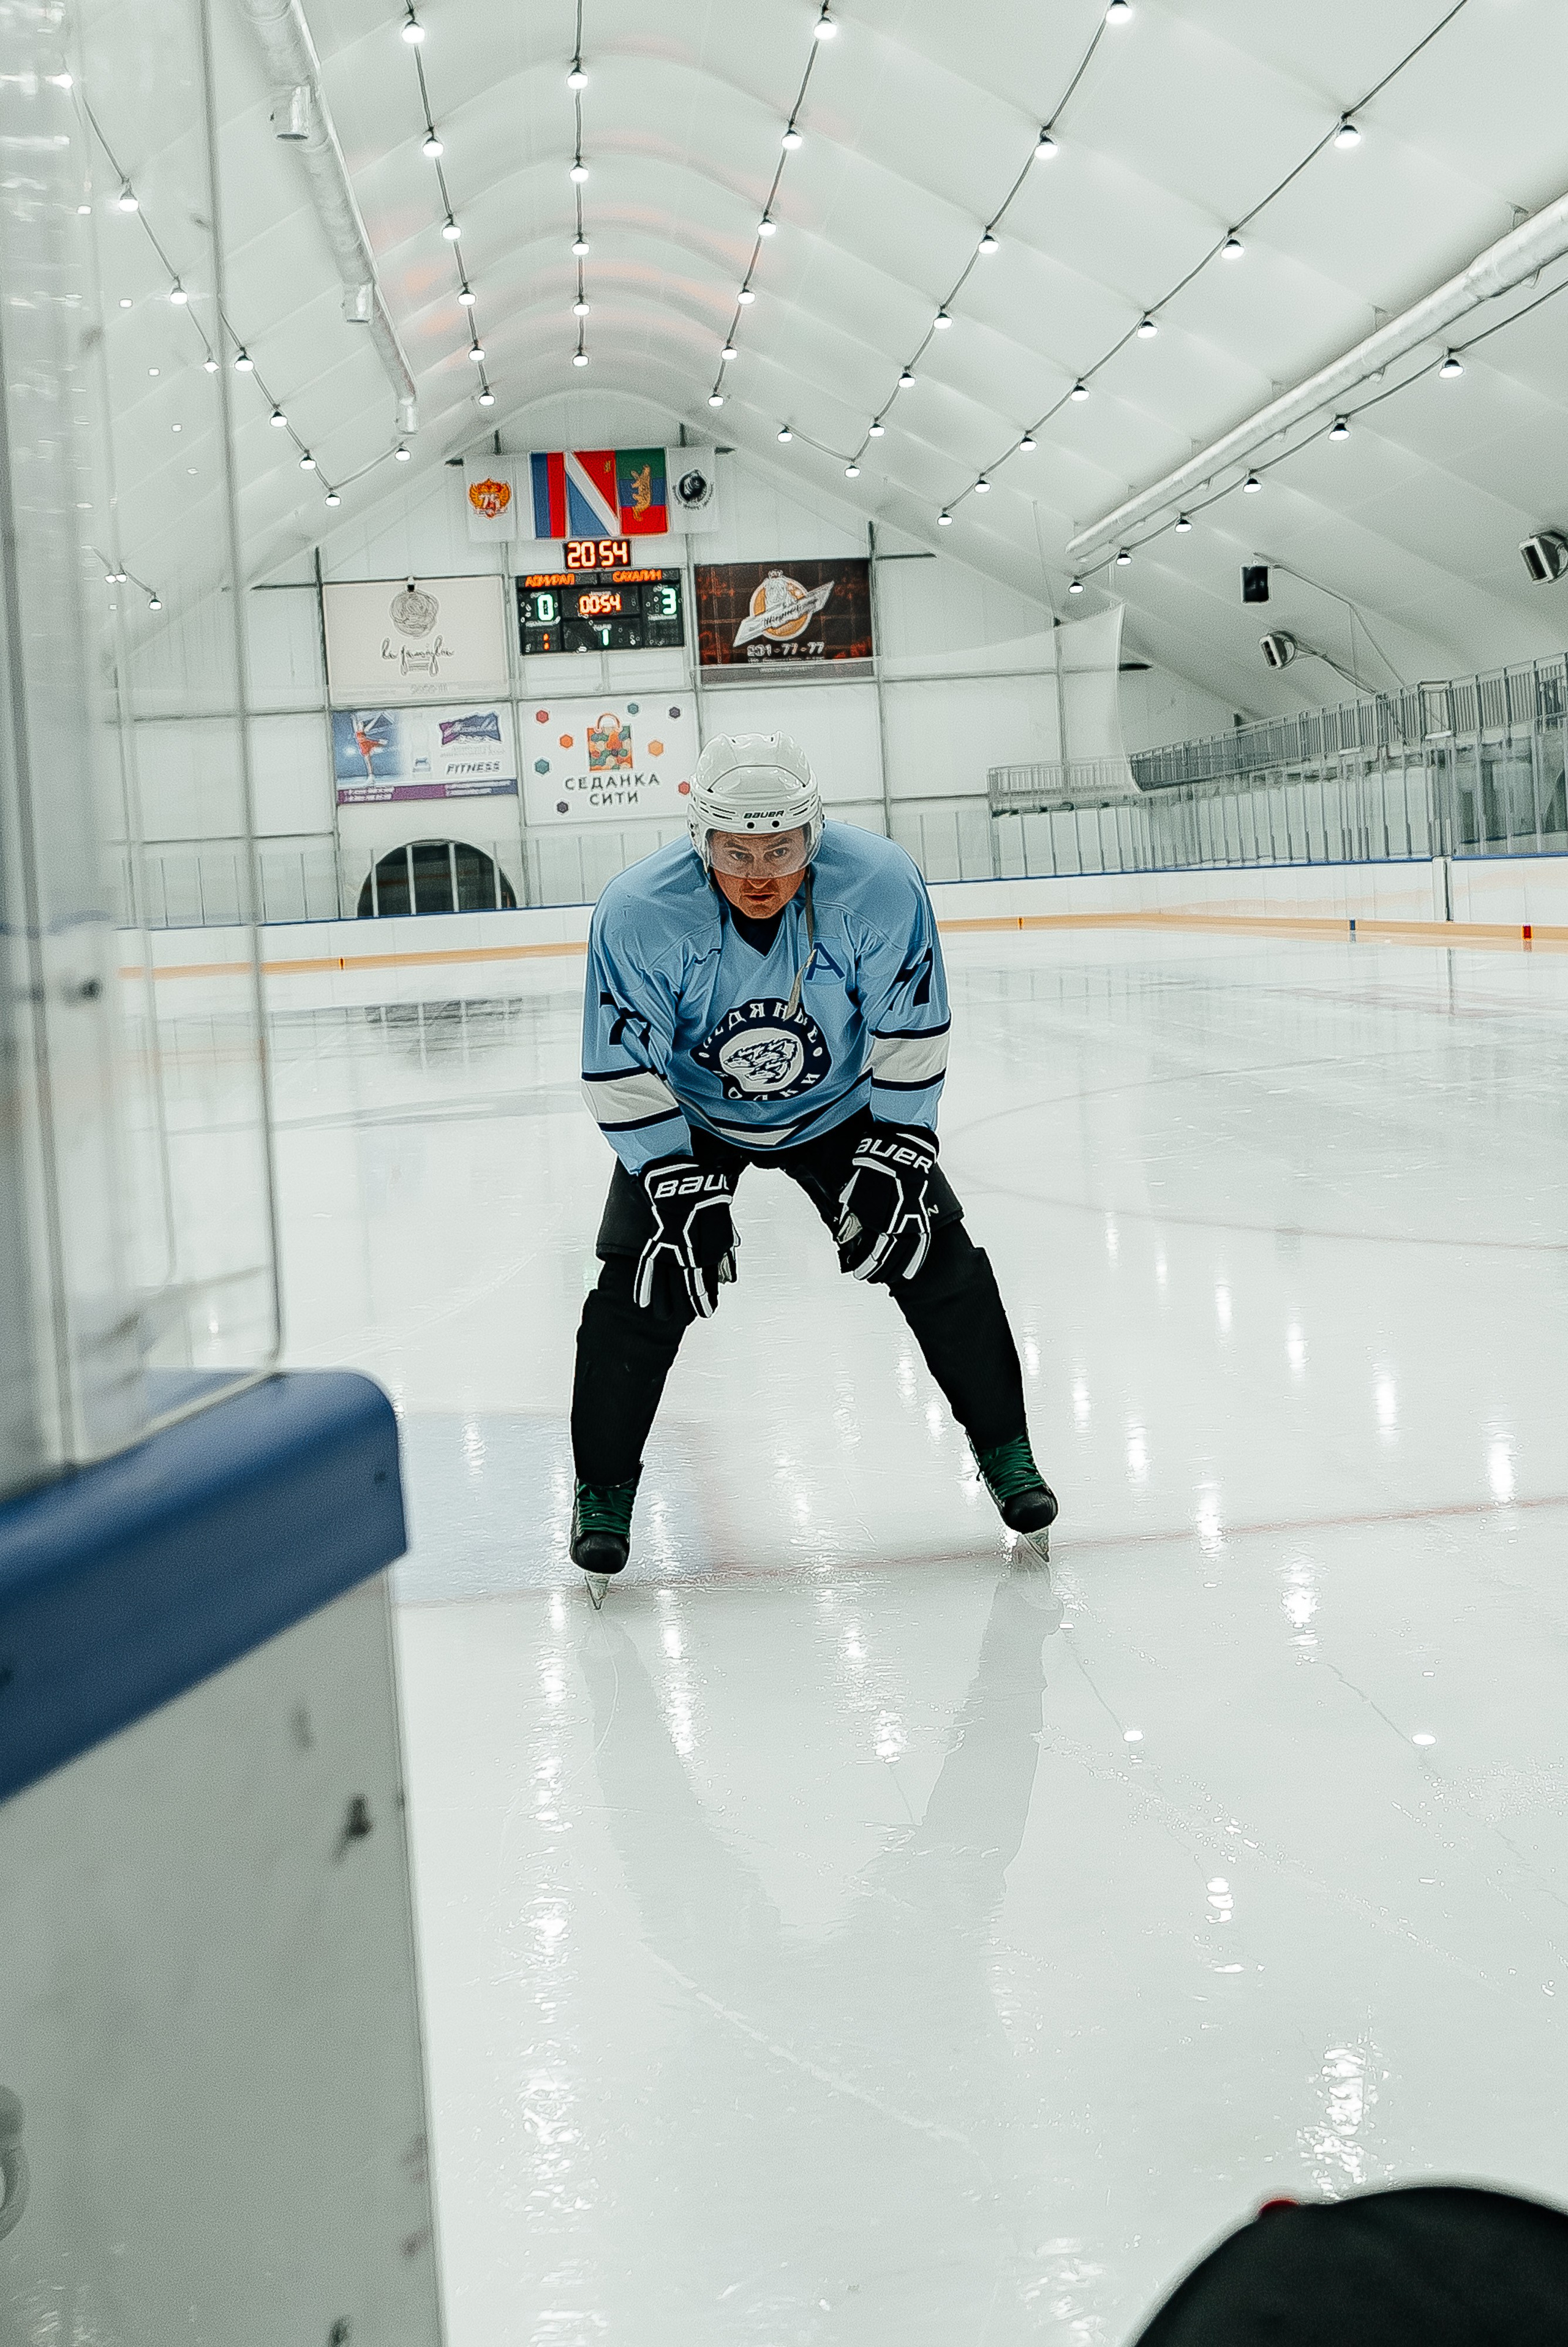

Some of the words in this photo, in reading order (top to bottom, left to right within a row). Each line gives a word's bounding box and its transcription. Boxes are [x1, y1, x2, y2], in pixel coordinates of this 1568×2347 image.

[525, 573, 575, 587] АДМИРАЛ
[612, 569, 662, 582] САХАЛИН
[537, 594, 554, 620] 0
[662, 587, 677, 614] 3
[447, 761, 500, 774] FITNESS
[565, 774, 660, 790] СЕДАНКА
[590, 792, 638, 805] СИТИ
[744, 810, 785, 819] BAUER
[855, 1138, 933, 1174] AUER
[654, 1174, 729, 1199] BAU
